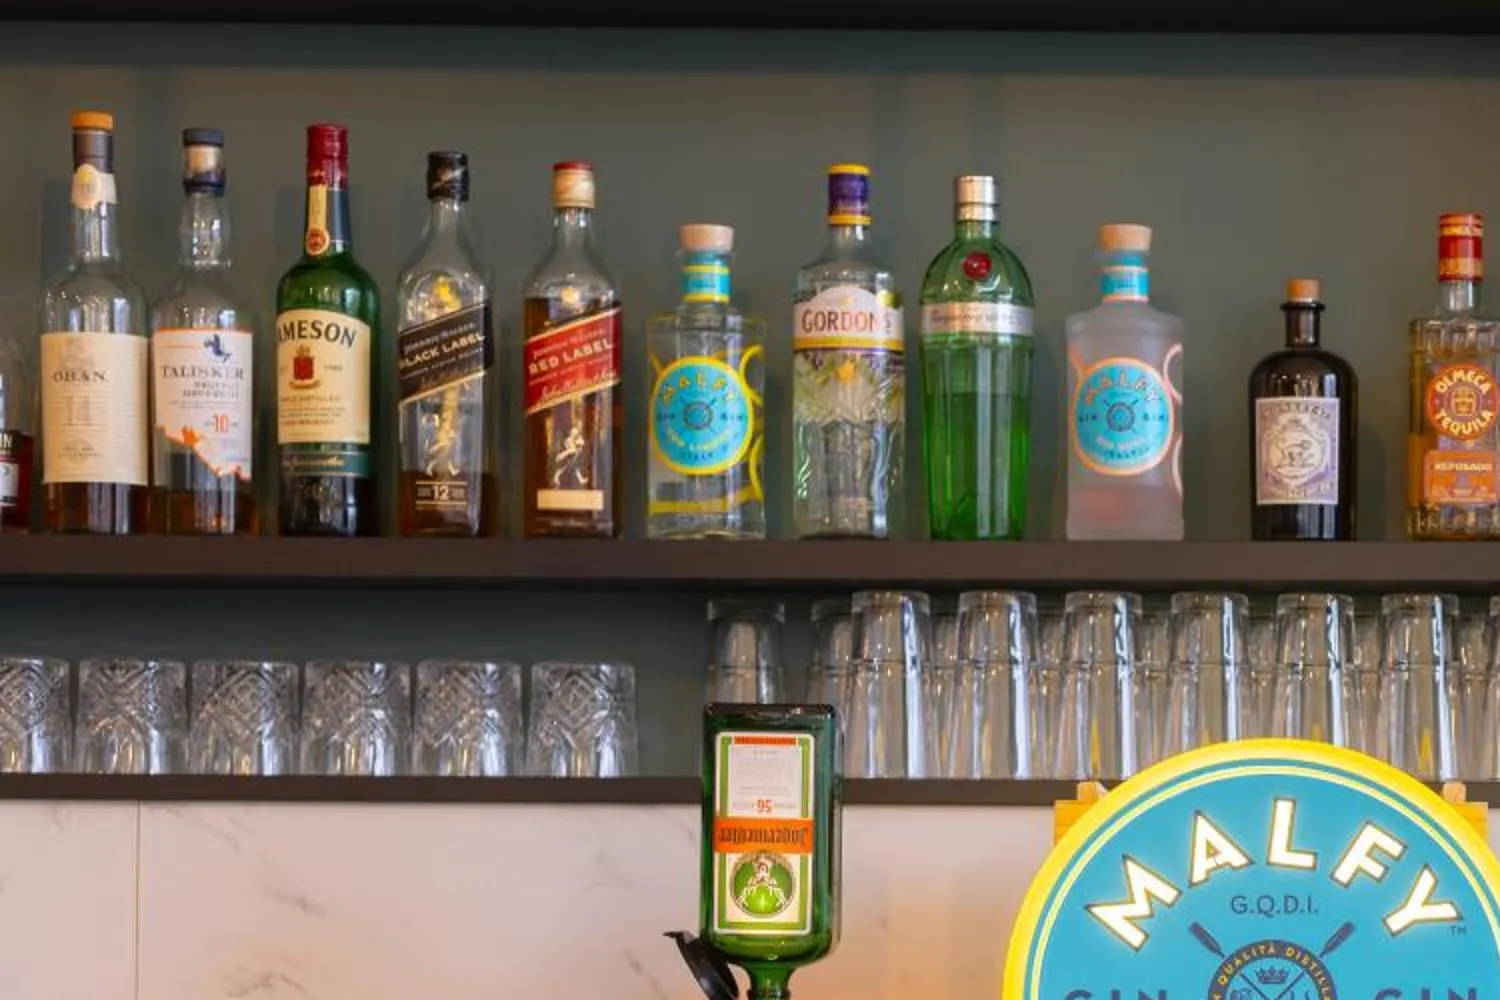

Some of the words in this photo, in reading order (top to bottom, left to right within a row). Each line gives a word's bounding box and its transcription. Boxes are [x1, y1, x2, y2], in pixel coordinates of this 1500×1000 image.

[528, 355, 560, 375] RED
[562, 338, 614, 363] LABEL
[161, 365, 244, 380] TALISKER
[1435, 369, 1492, 394] OLMECA
[1435, 408, 1493, 436] TEQUILA
[433, 485, 449, 500] 12
[1086, 797, 1464, 952] MALFY
[1230, 894, 1319, 919] G.Q.D.I.
